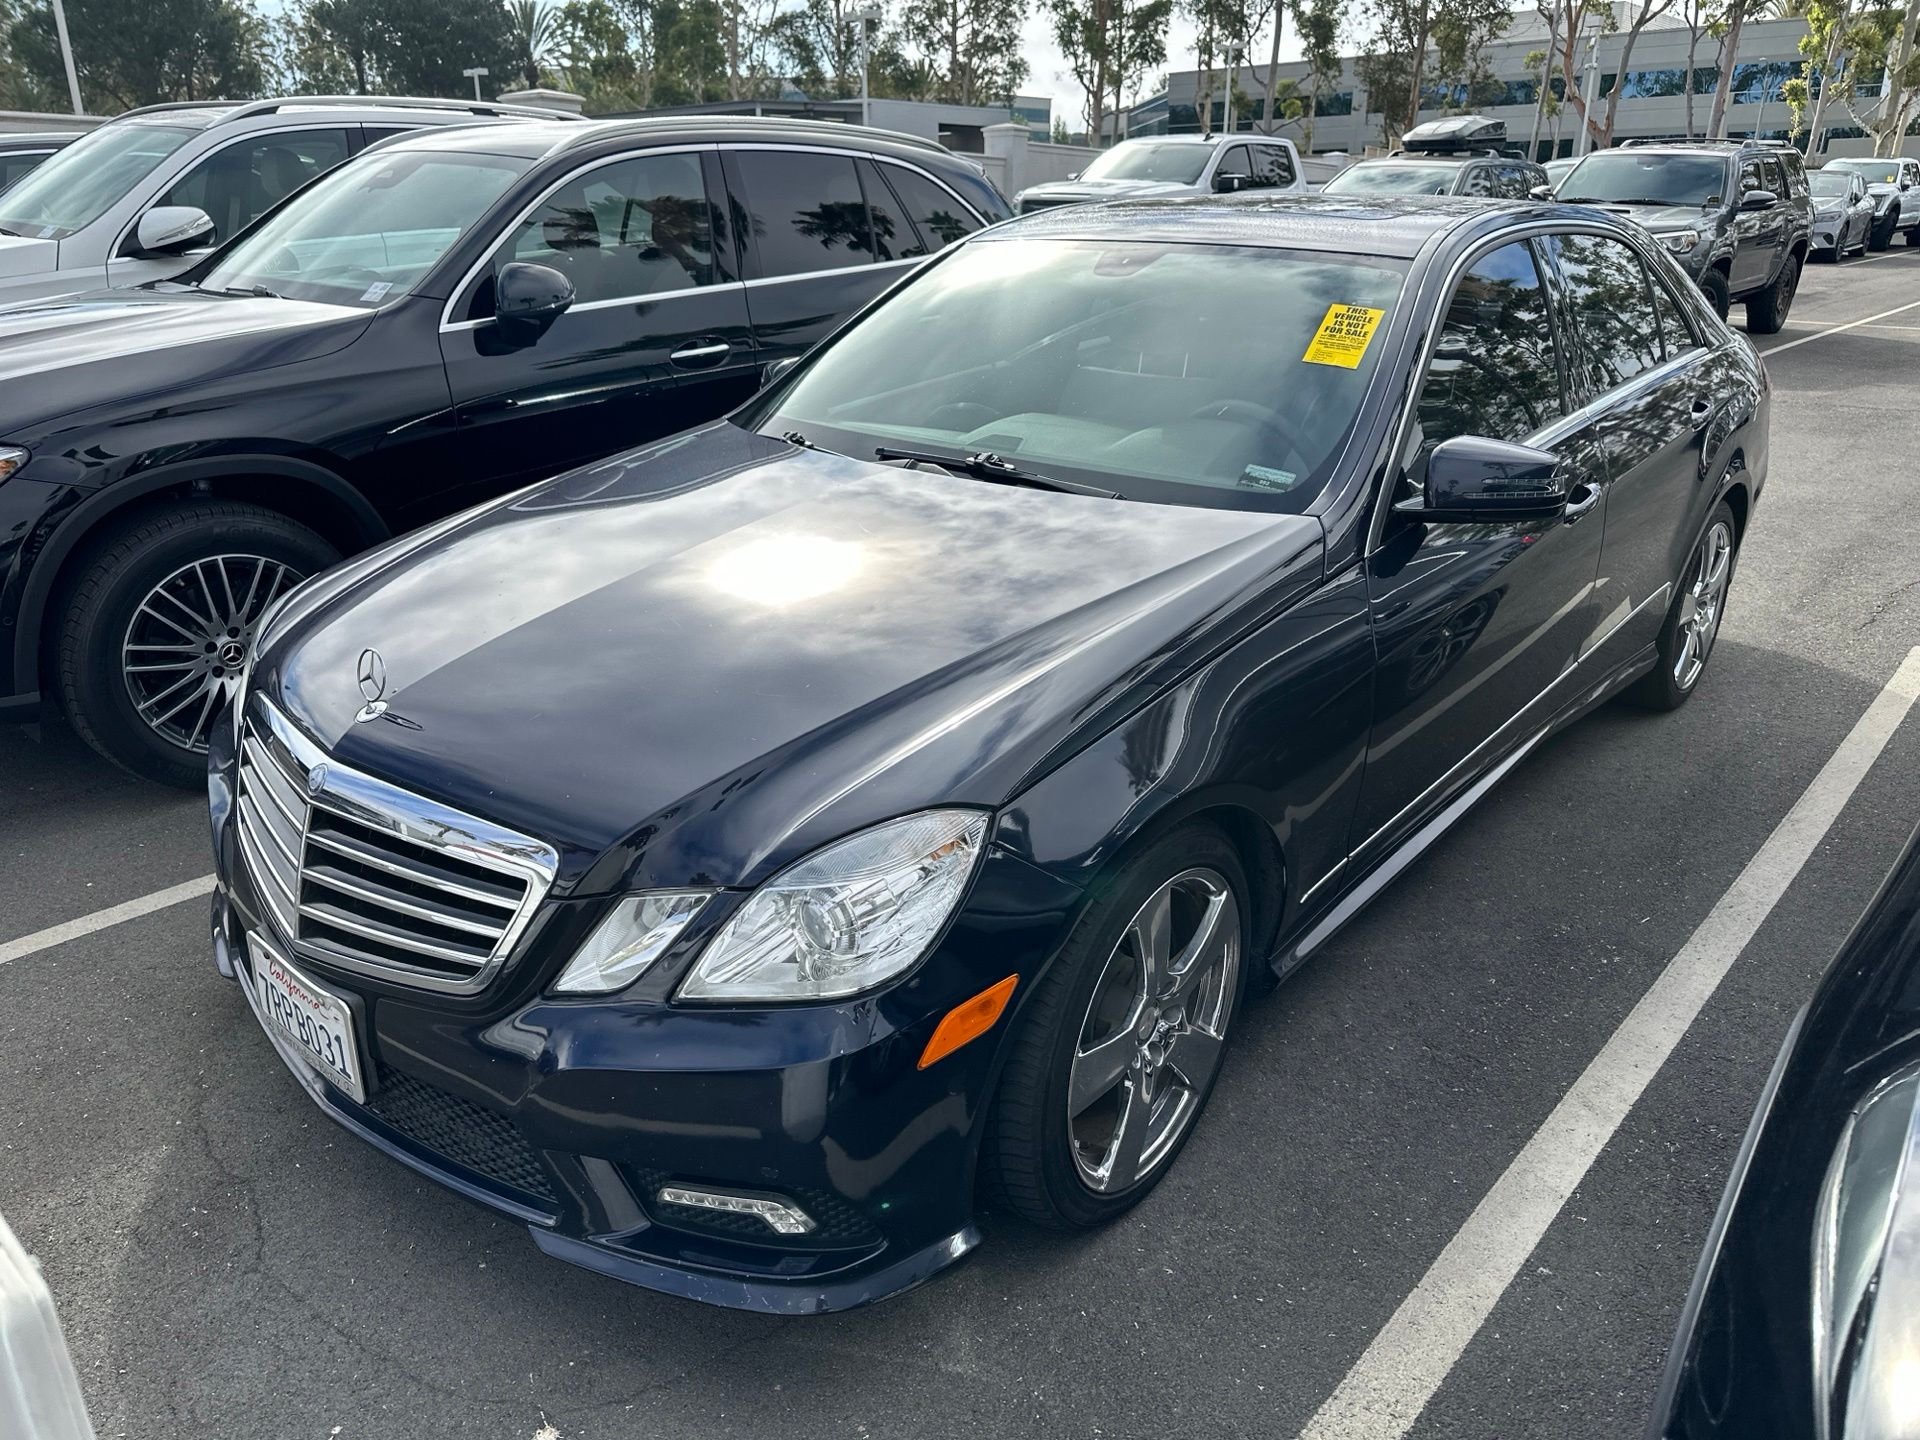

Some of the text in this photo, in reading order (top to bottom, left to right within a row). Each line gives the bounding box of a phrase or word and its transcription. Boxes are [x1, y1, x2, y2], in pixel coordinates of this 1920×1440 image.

[1346, 307, 1369, 315] THIS
[1333, 312, 1375, 324] VEHICLE
[1345, 321, 1367, 330] NOT
[1323, 326, 1369, 338] FOR SALE
[269, 959, 320, 1010] California
[259, 971, 352, 1080] 7RPB031
